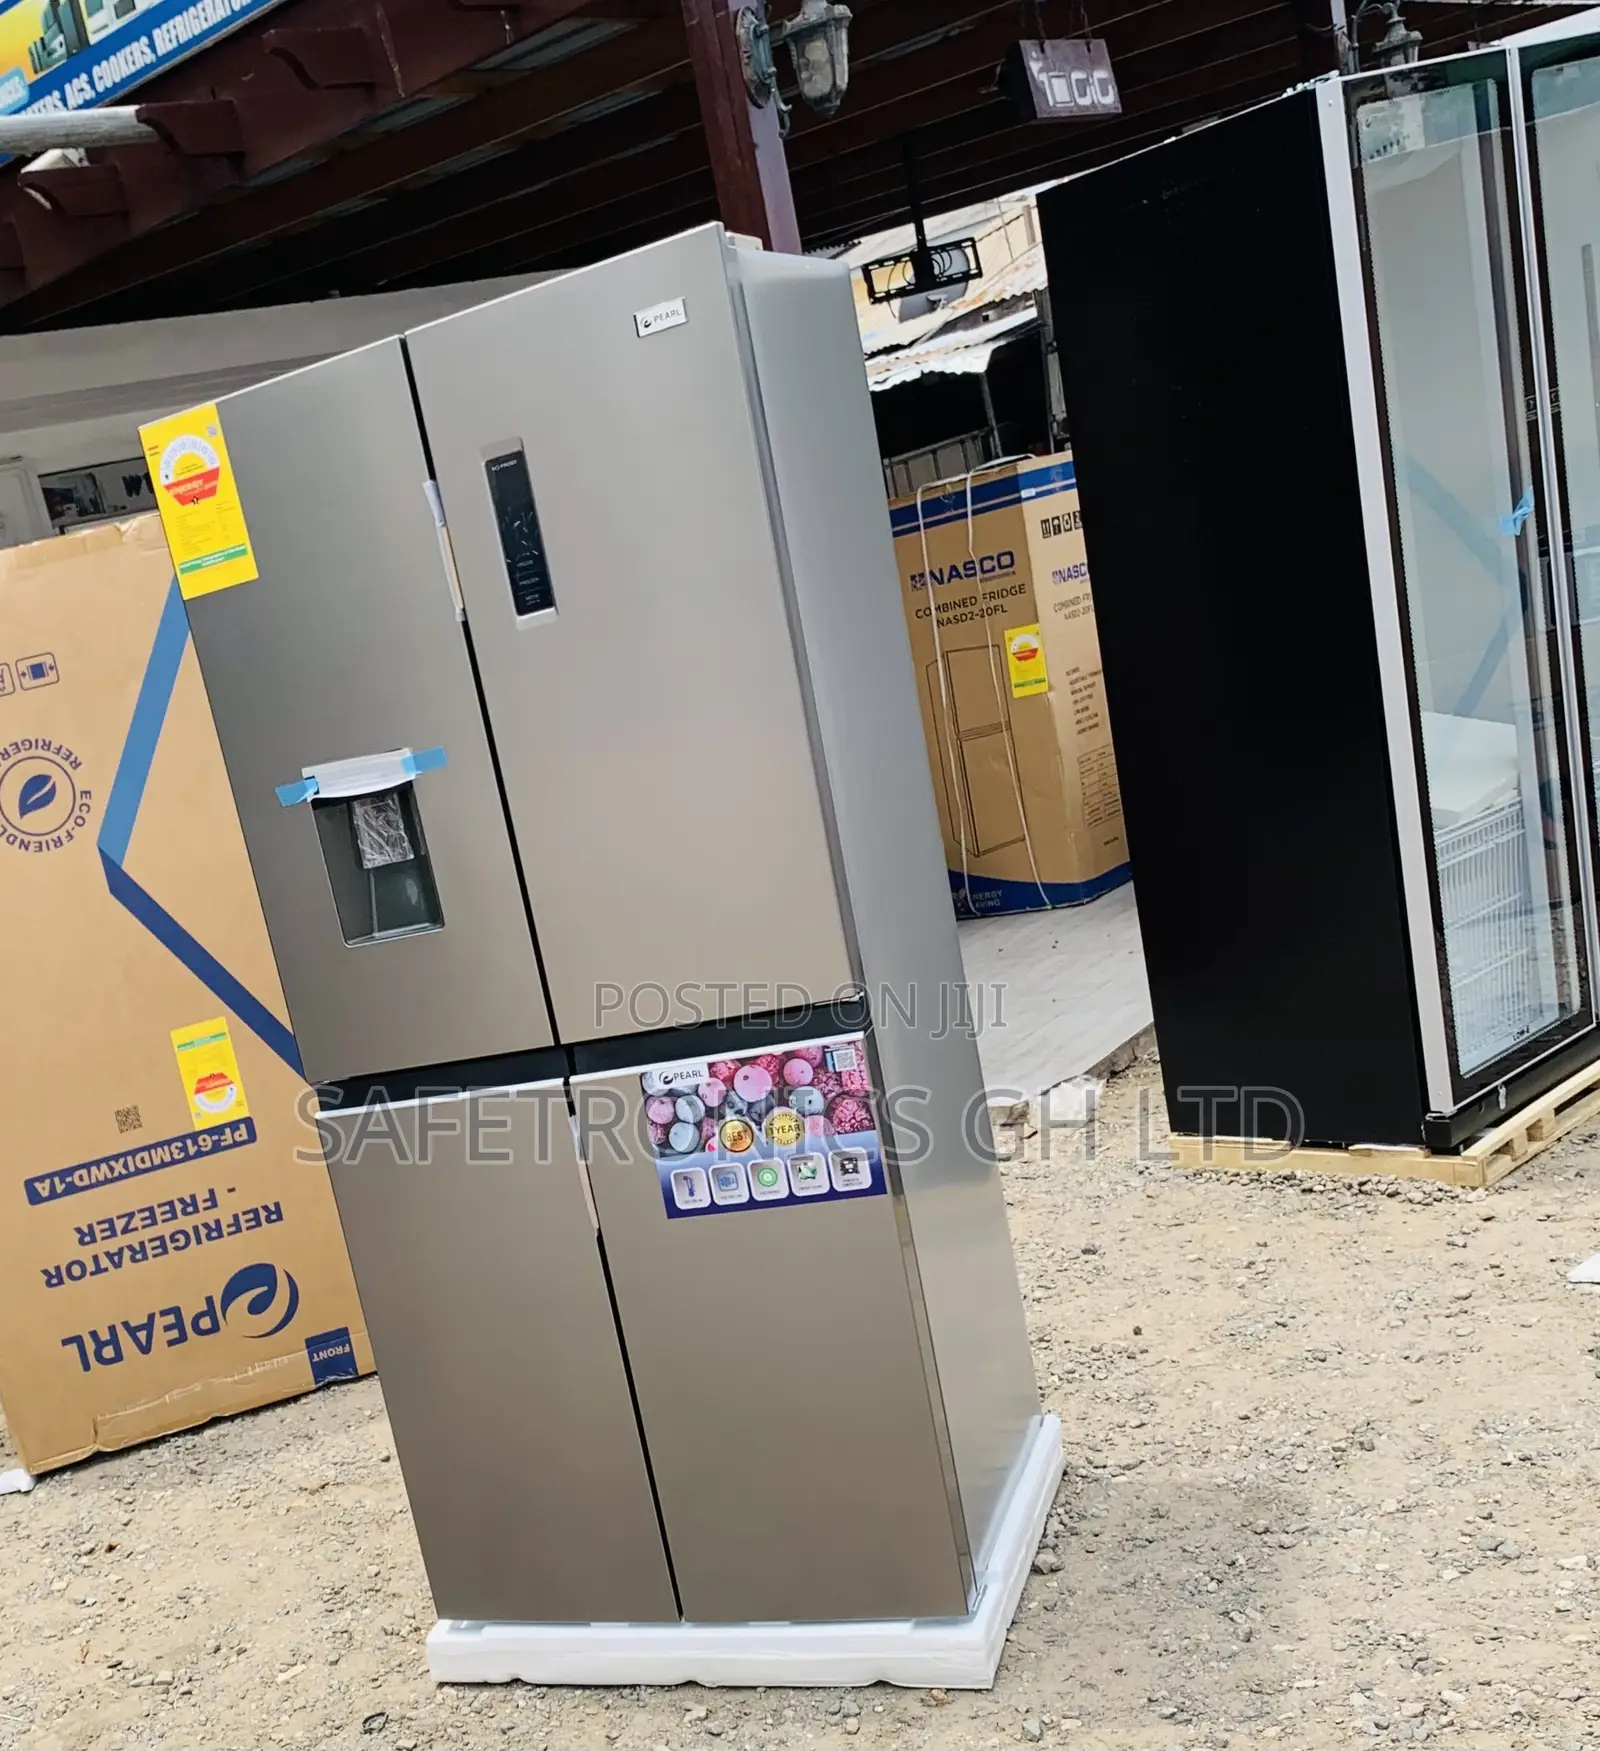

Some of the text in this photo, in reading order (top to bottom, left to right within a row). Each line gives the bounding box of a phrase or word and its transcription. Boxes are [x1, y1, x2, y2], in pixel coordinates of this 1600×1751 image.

[91, 35, 157, 94] COOKERS,
[653, 309, 682, 322] PEARL
[928, 550, 1016, 586] NASCO
[1058, 562, 1090, 583] NASC
[915, 583, 1027, 620] COMBINED FRIDGE
[936, 603, 1008, 629] NASD2-20FL
[0, 738, 82, 771] REFRIGER
[973, 889, 1003, 900] NERGY
[975, 900, 1001, 909] AVING
[674, 1069, 704, 1082] PEARL
[725, 1128, 749, 1143] BEST
[775, 1123, 801, 1135] YEAR
[33, 1121, 249, 1198] PF-613MDIXWD-1A
[73, 1187, 219, 1247] FREEZER
[40, 1201, 285, 1289] REFRIGERATOR
[61, 1295, 222, 1373] PEARL
[312, 1343, 350, 1363] FRONT
